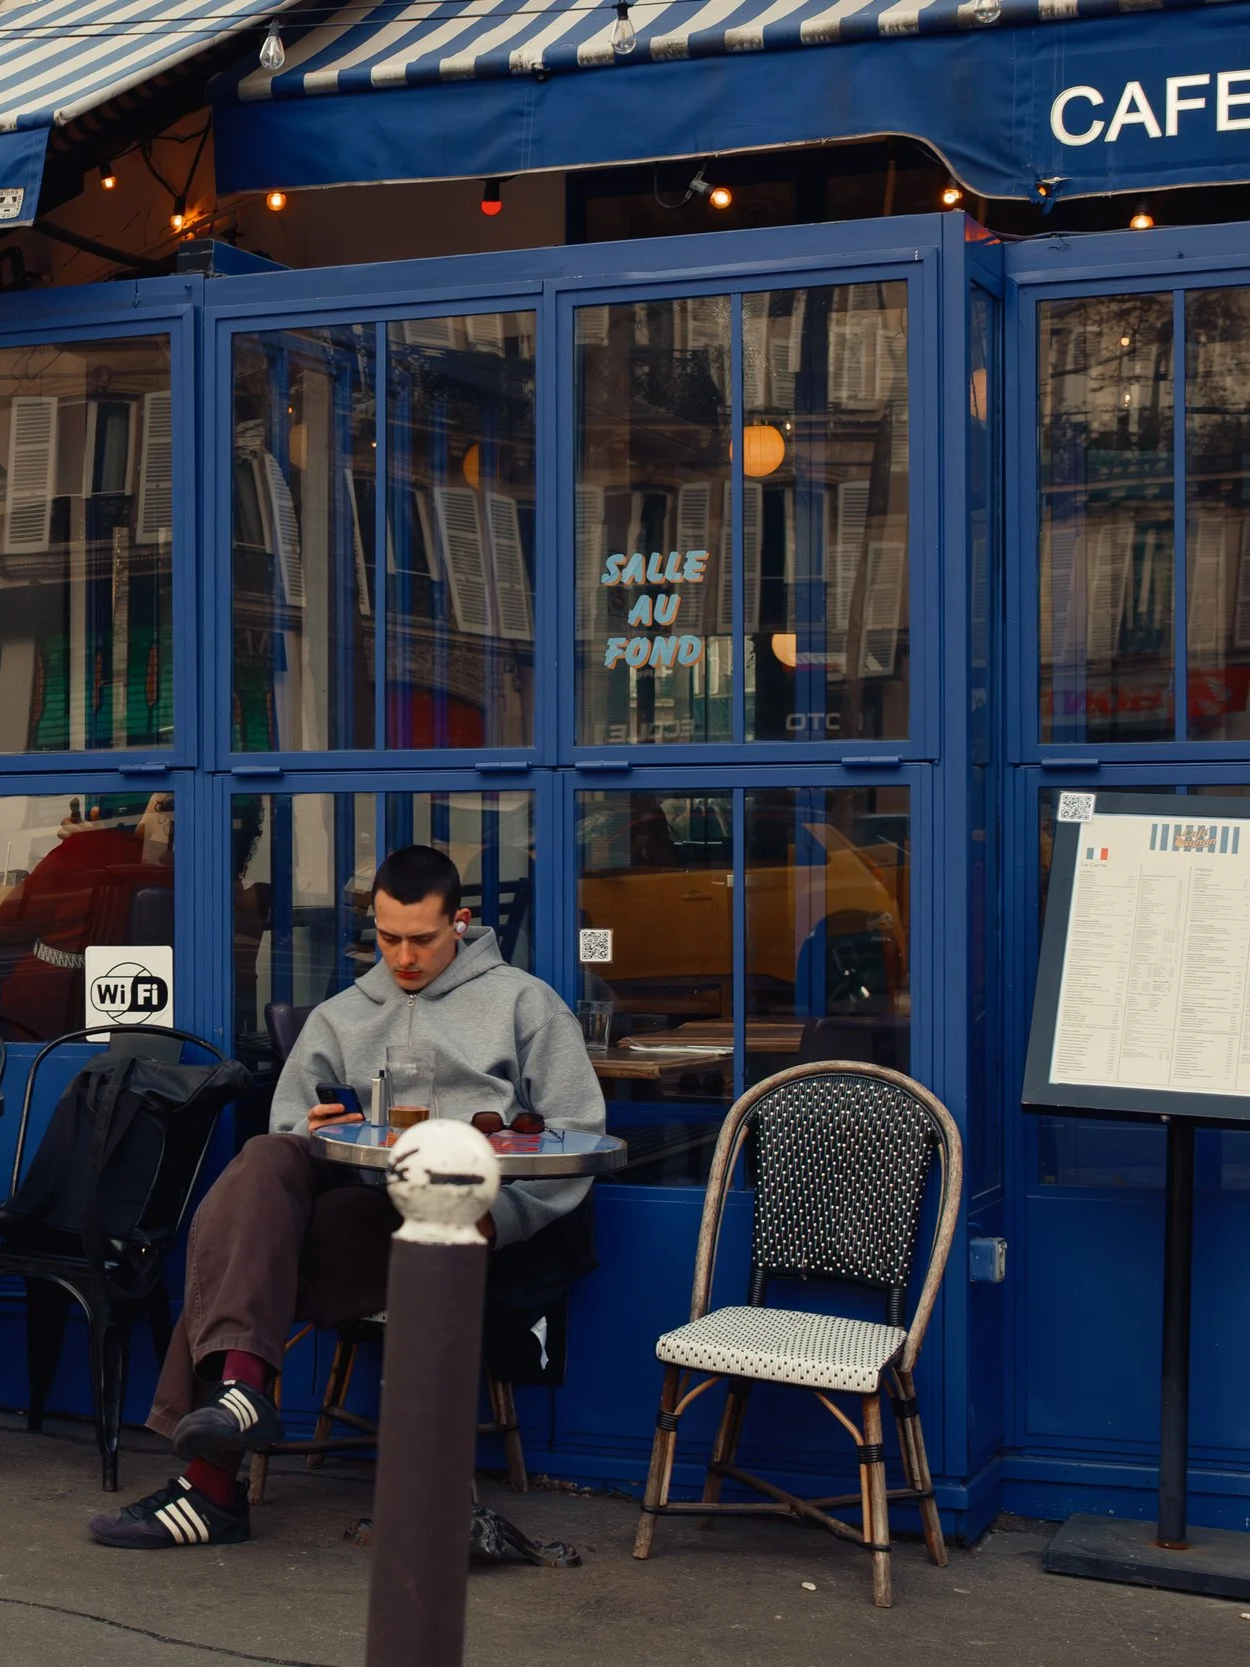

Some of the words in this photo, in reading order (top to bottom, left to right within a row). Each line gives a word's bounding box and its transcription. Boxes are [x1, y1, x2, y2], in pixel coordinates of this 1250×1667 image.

[1050, 69, 1250, 147] CAFE
[601, 550, 710, 586] SALLE
[628, 594, 681, 627] AU
[604, 634, 704, 670] FOND
